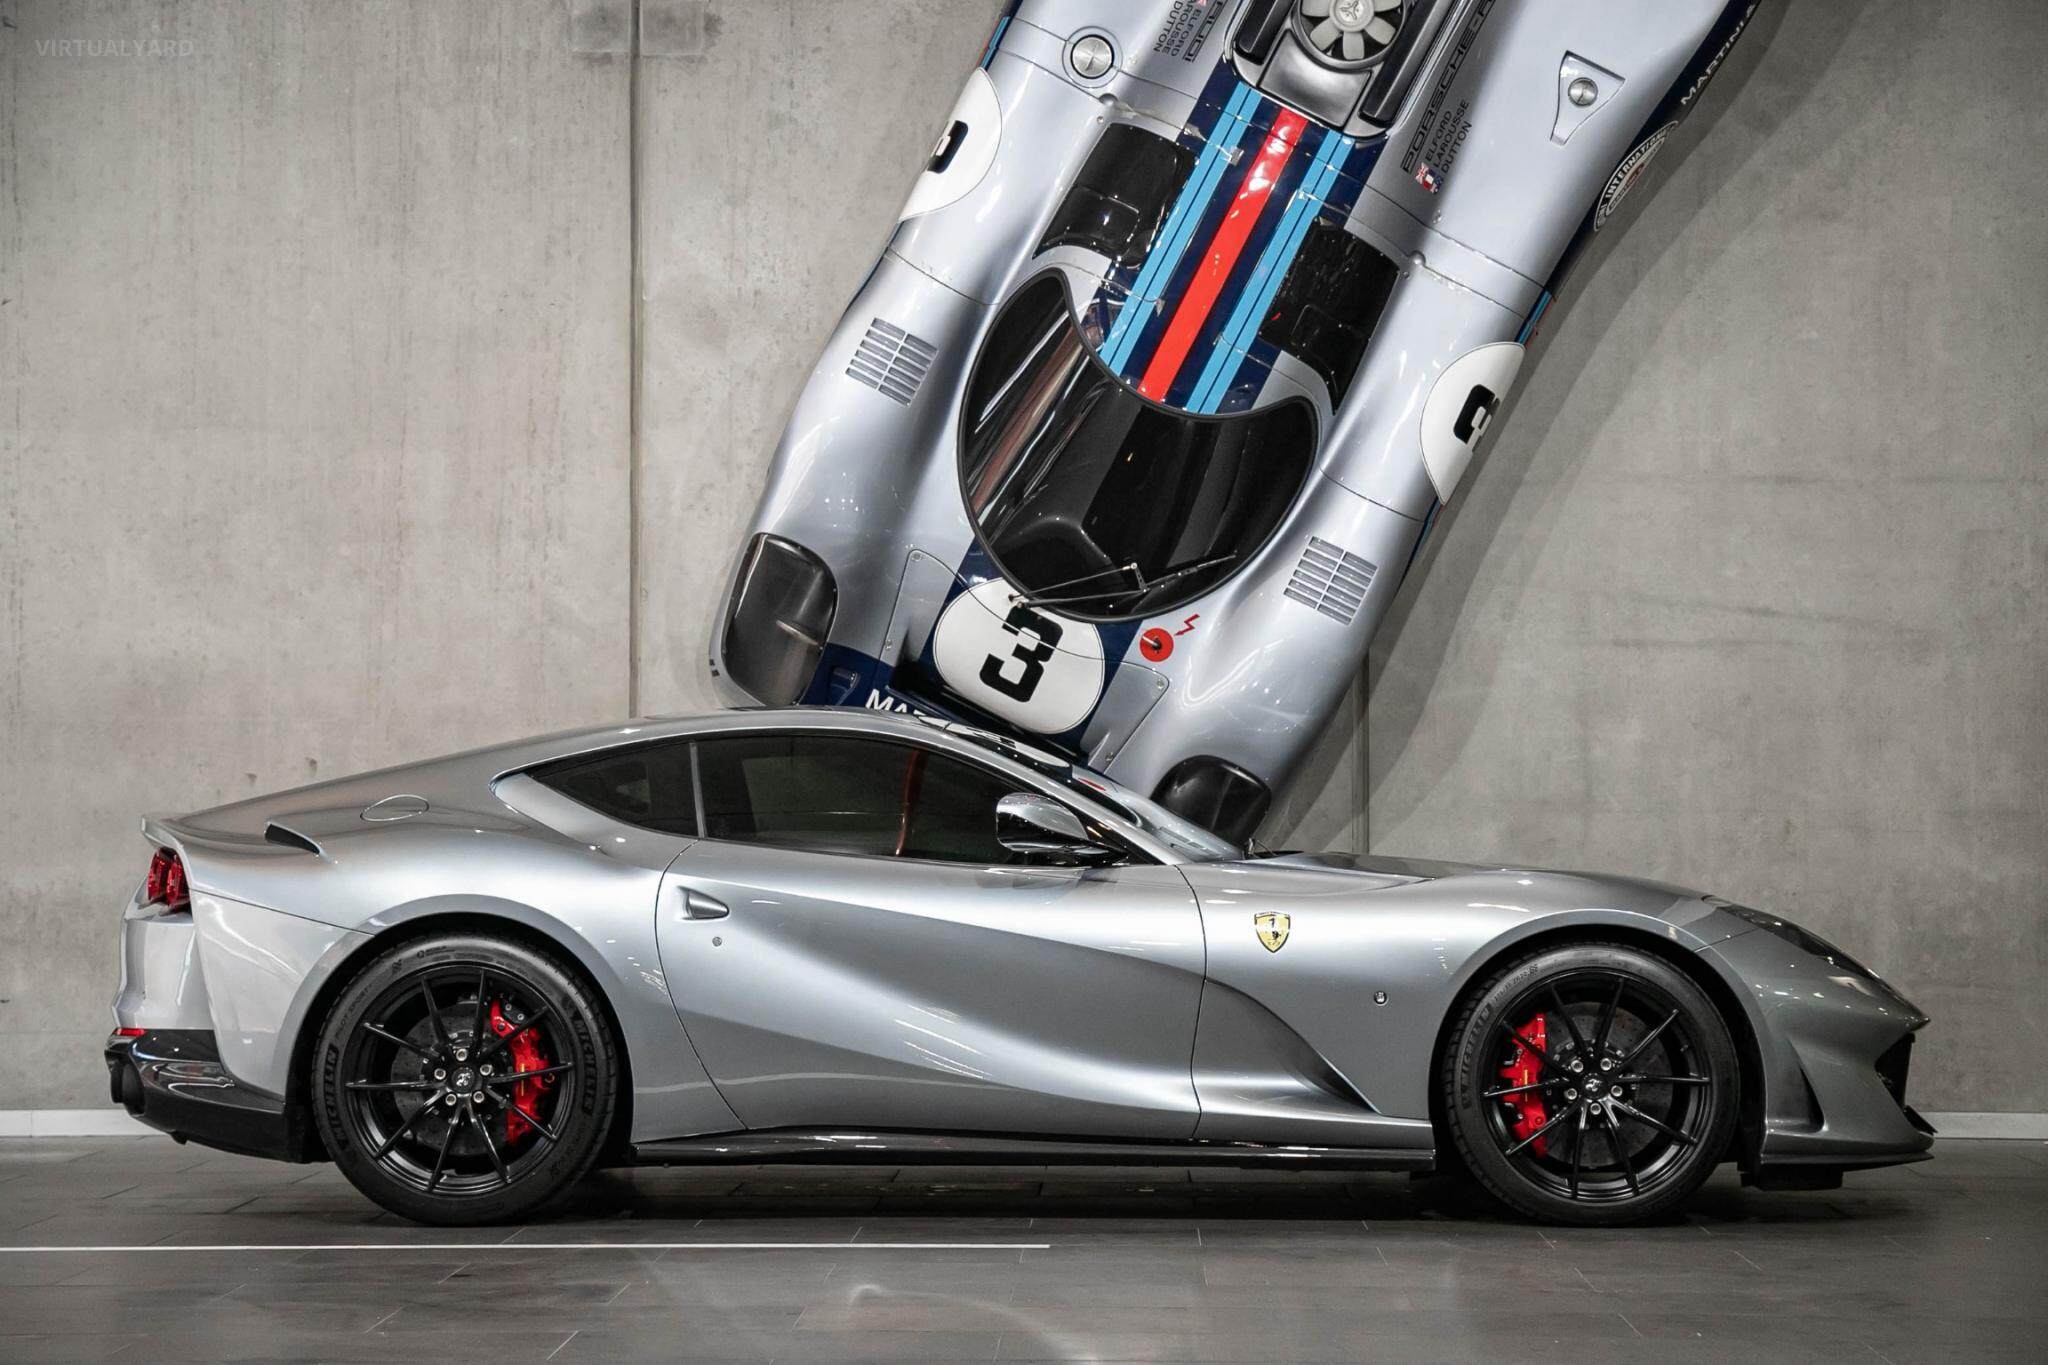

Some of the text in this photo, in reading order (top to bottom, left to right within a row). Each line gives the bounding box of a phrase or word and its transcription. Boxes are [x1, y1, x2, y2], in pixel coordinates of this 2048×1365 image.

[1153, 1, 1183, 52] DUTTON
[1171, 9, 1202, 56] ELFORD
[1681, 21, 1744, 104] MARTINI
[1425, 110, 1452, 161] ELFORD
[1433, 101, 1469, 168] LAROUSSE
[1441, 121, 1472, 173] DUTTON
[1453, 384, 1500, 452] 3
[979, 605, 1063, 702] 3
[865, 688, 926, 716] MA
[325, 1050, 346, 1144] MICHELIN
[574, 1020, 595, 1110] MICHELIN
